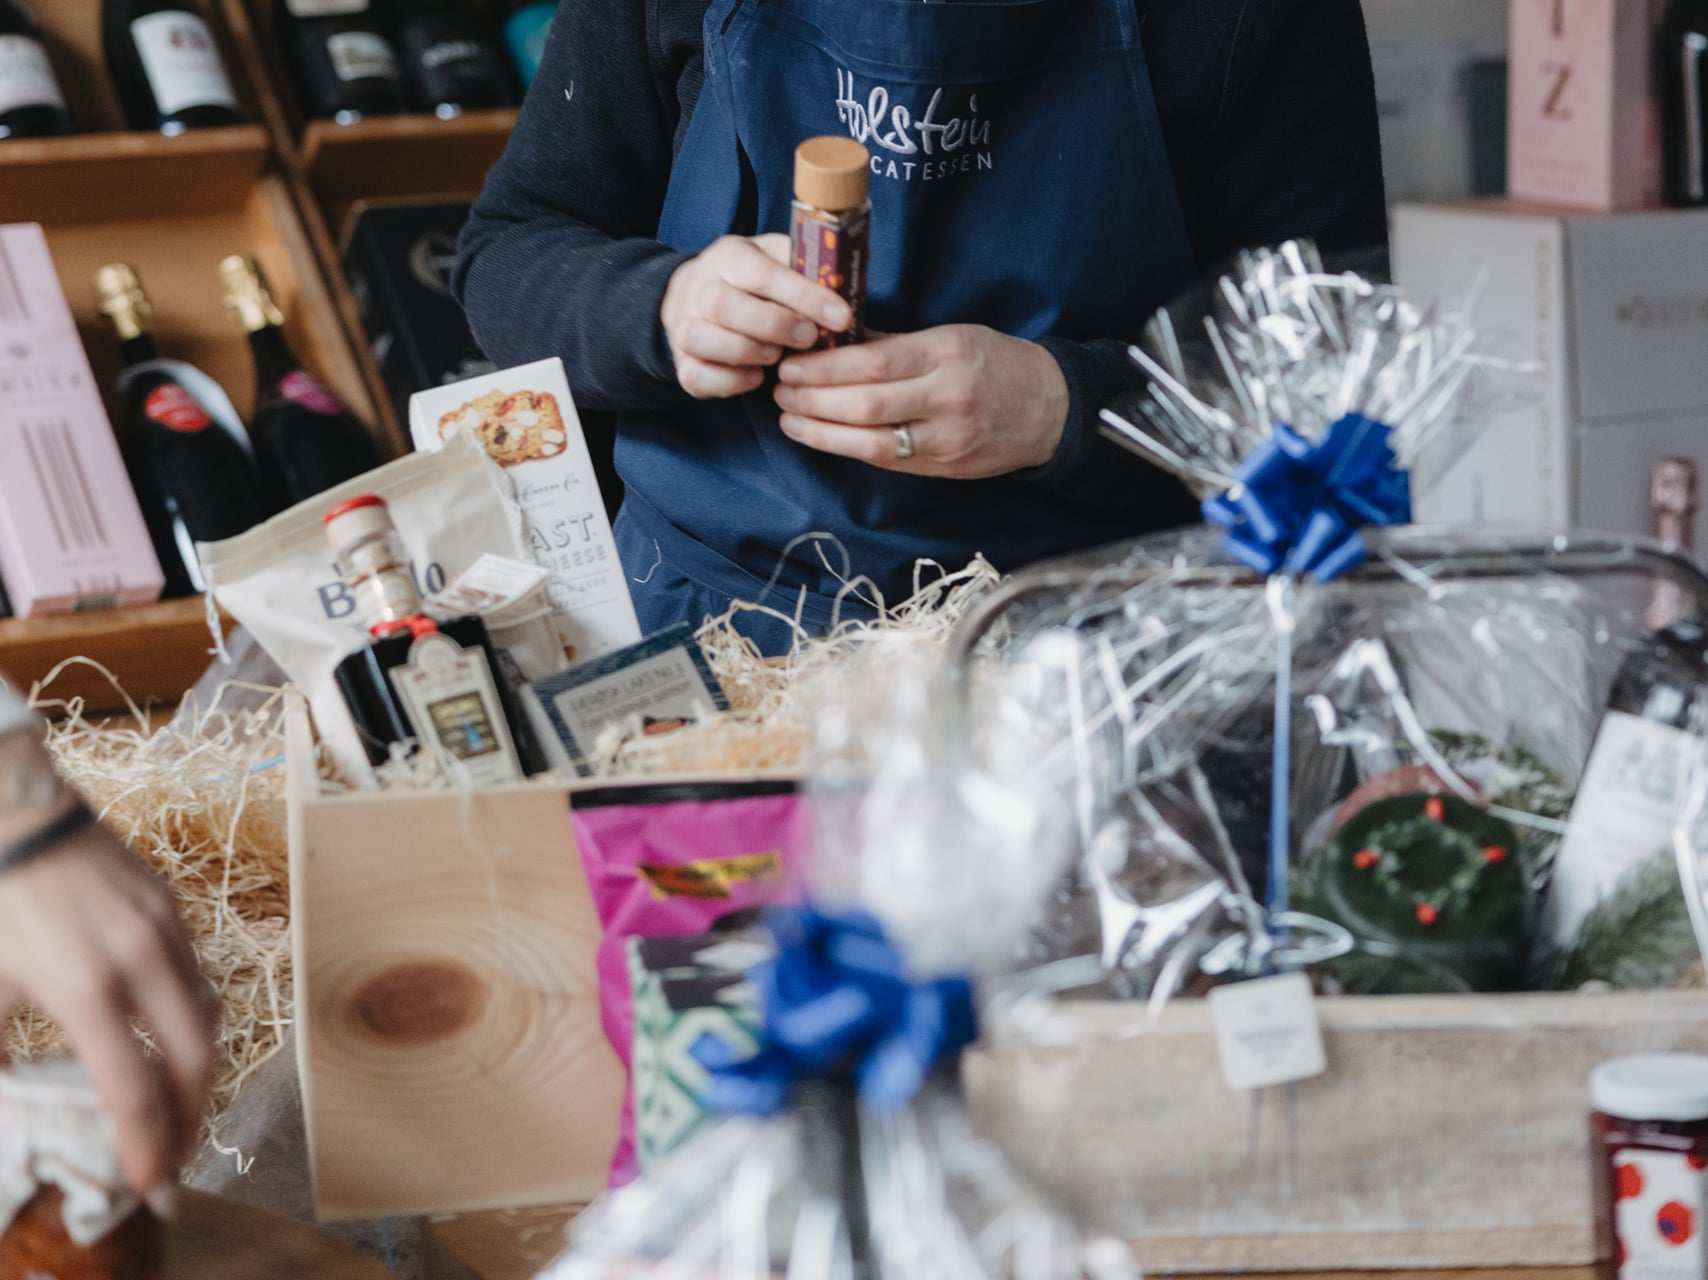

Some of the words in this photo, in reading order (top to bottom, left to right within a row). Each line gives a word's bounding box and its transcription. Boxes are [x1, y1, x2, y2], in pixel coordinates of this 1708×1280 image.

[835, 68, 990, 155] Holstein
[870, 152, 993, 182] CATESSEN
[531, 512, 594, 553] AST
